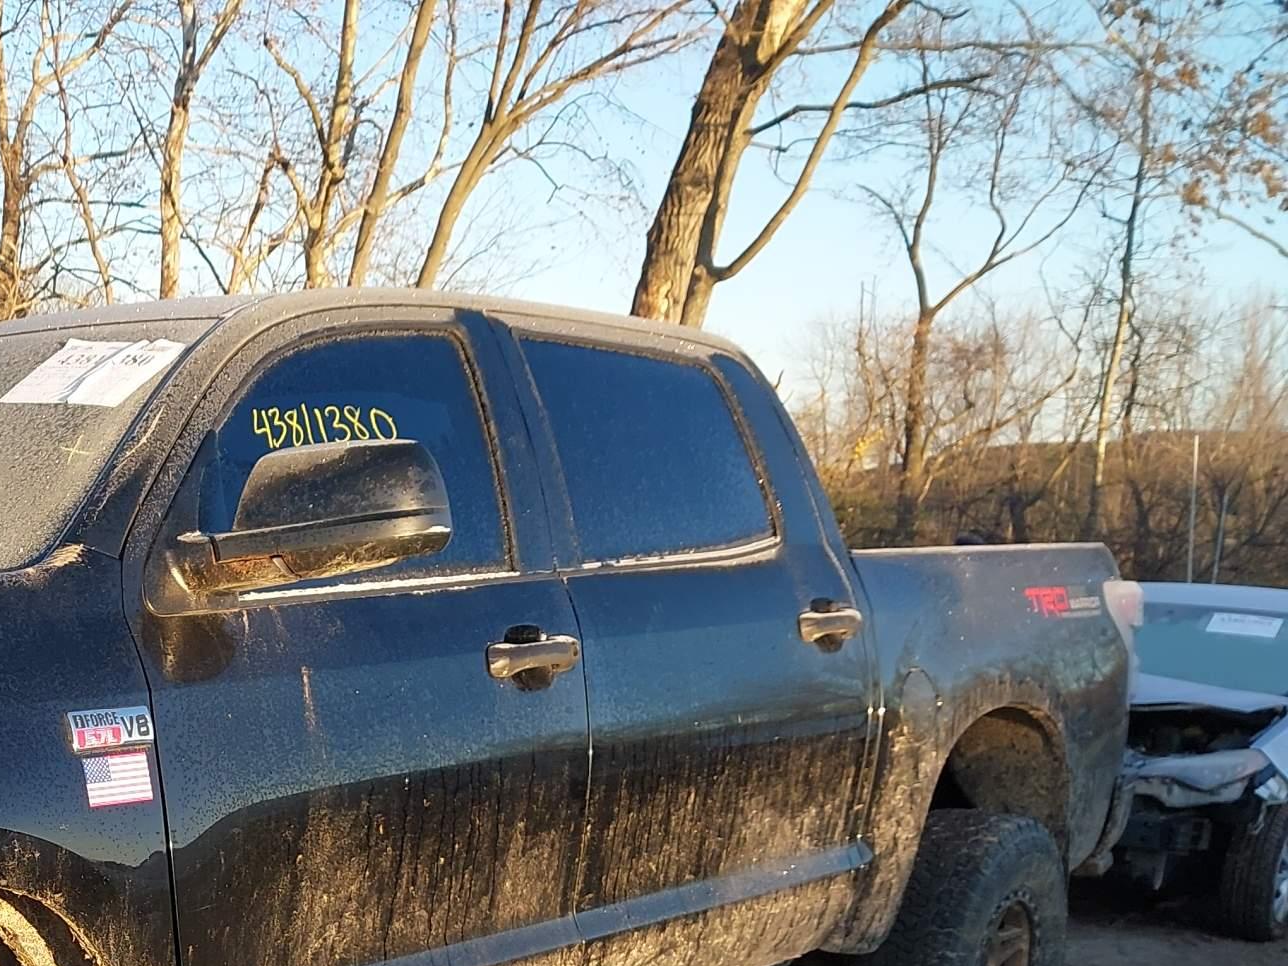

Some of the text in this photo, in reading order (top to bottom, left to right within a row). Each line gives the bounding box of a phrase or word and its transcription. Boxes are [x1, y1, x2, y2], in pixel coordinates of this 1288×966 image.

[252, 402, 398, 449] 43811380
[1024, 586, 1070, 611] TRD
[120, 714, 150, 738] V8
